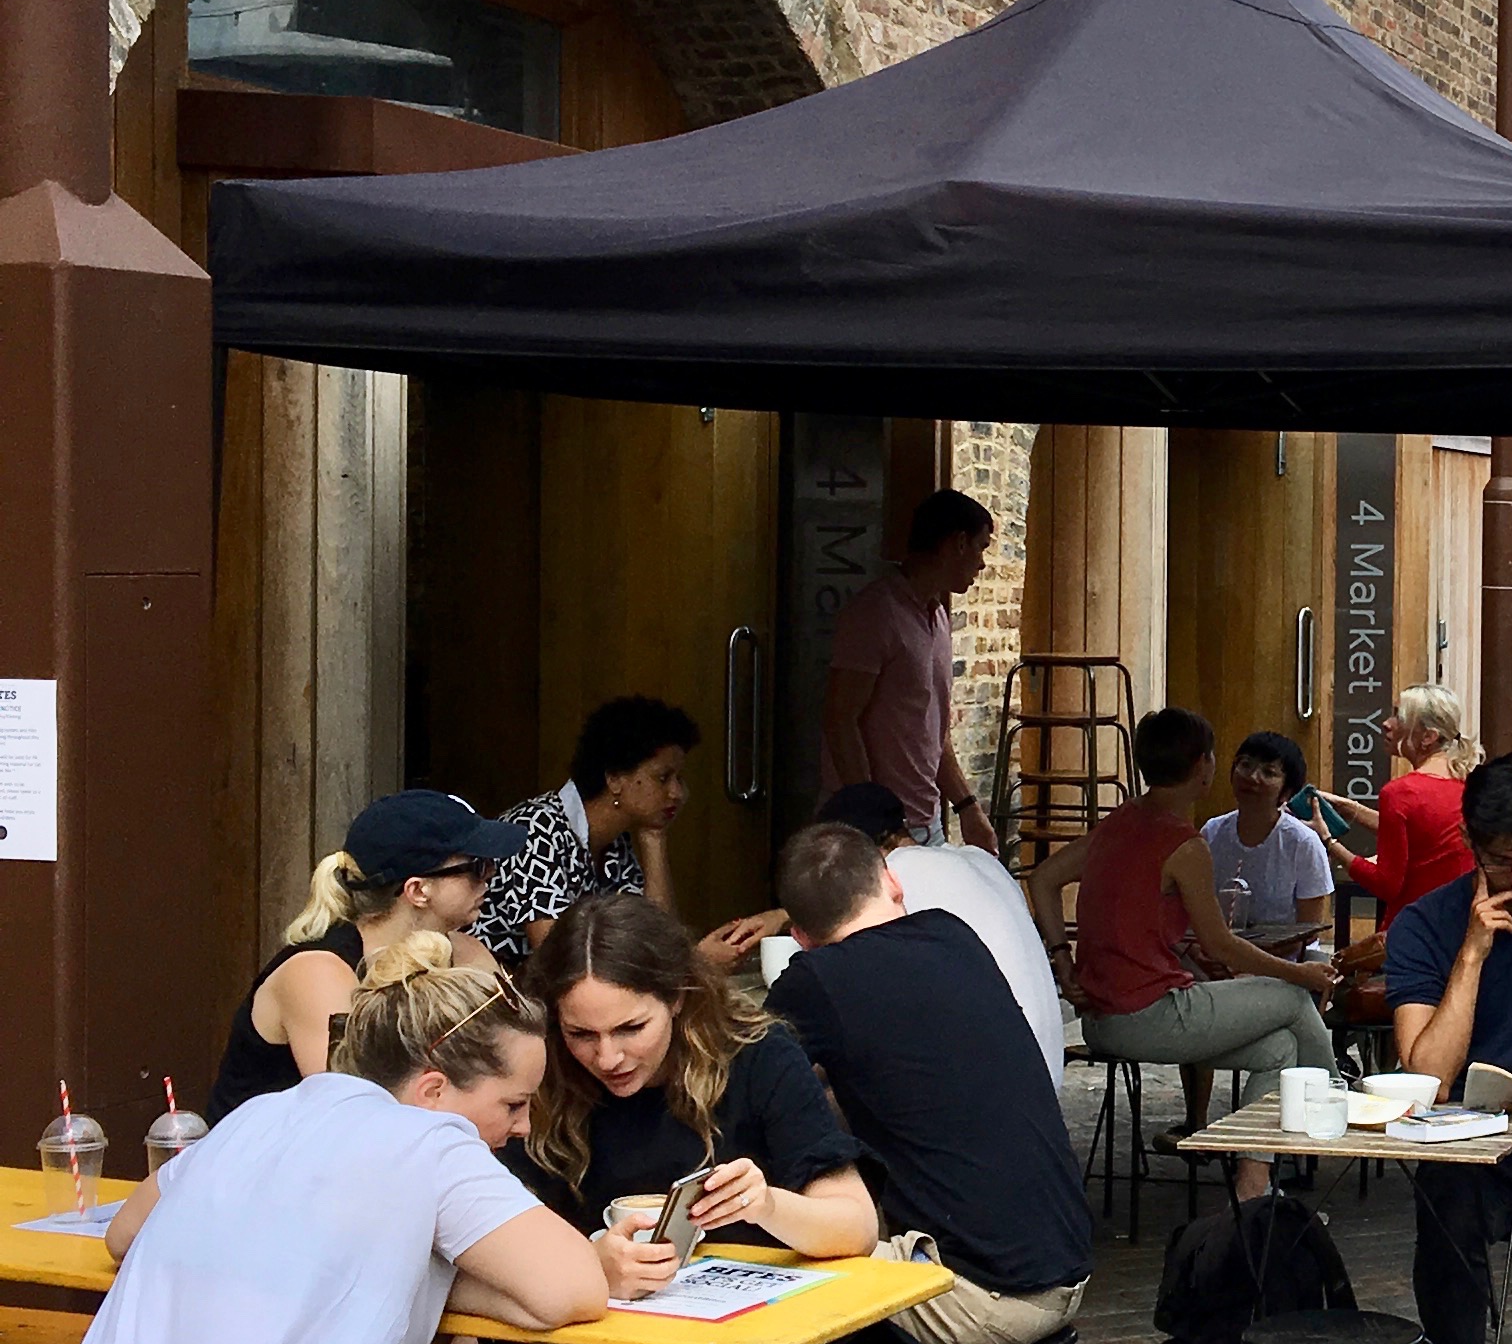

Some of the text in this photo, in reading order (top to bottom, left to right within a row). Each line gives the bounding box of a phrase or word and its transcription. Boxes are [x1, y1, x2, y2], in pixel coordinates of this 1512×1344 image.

[816, 465, 867, 497] 4
[1347, 500, 1386, 801] 4 Market Yard
[700, 1266, 802, 1282] BITES
